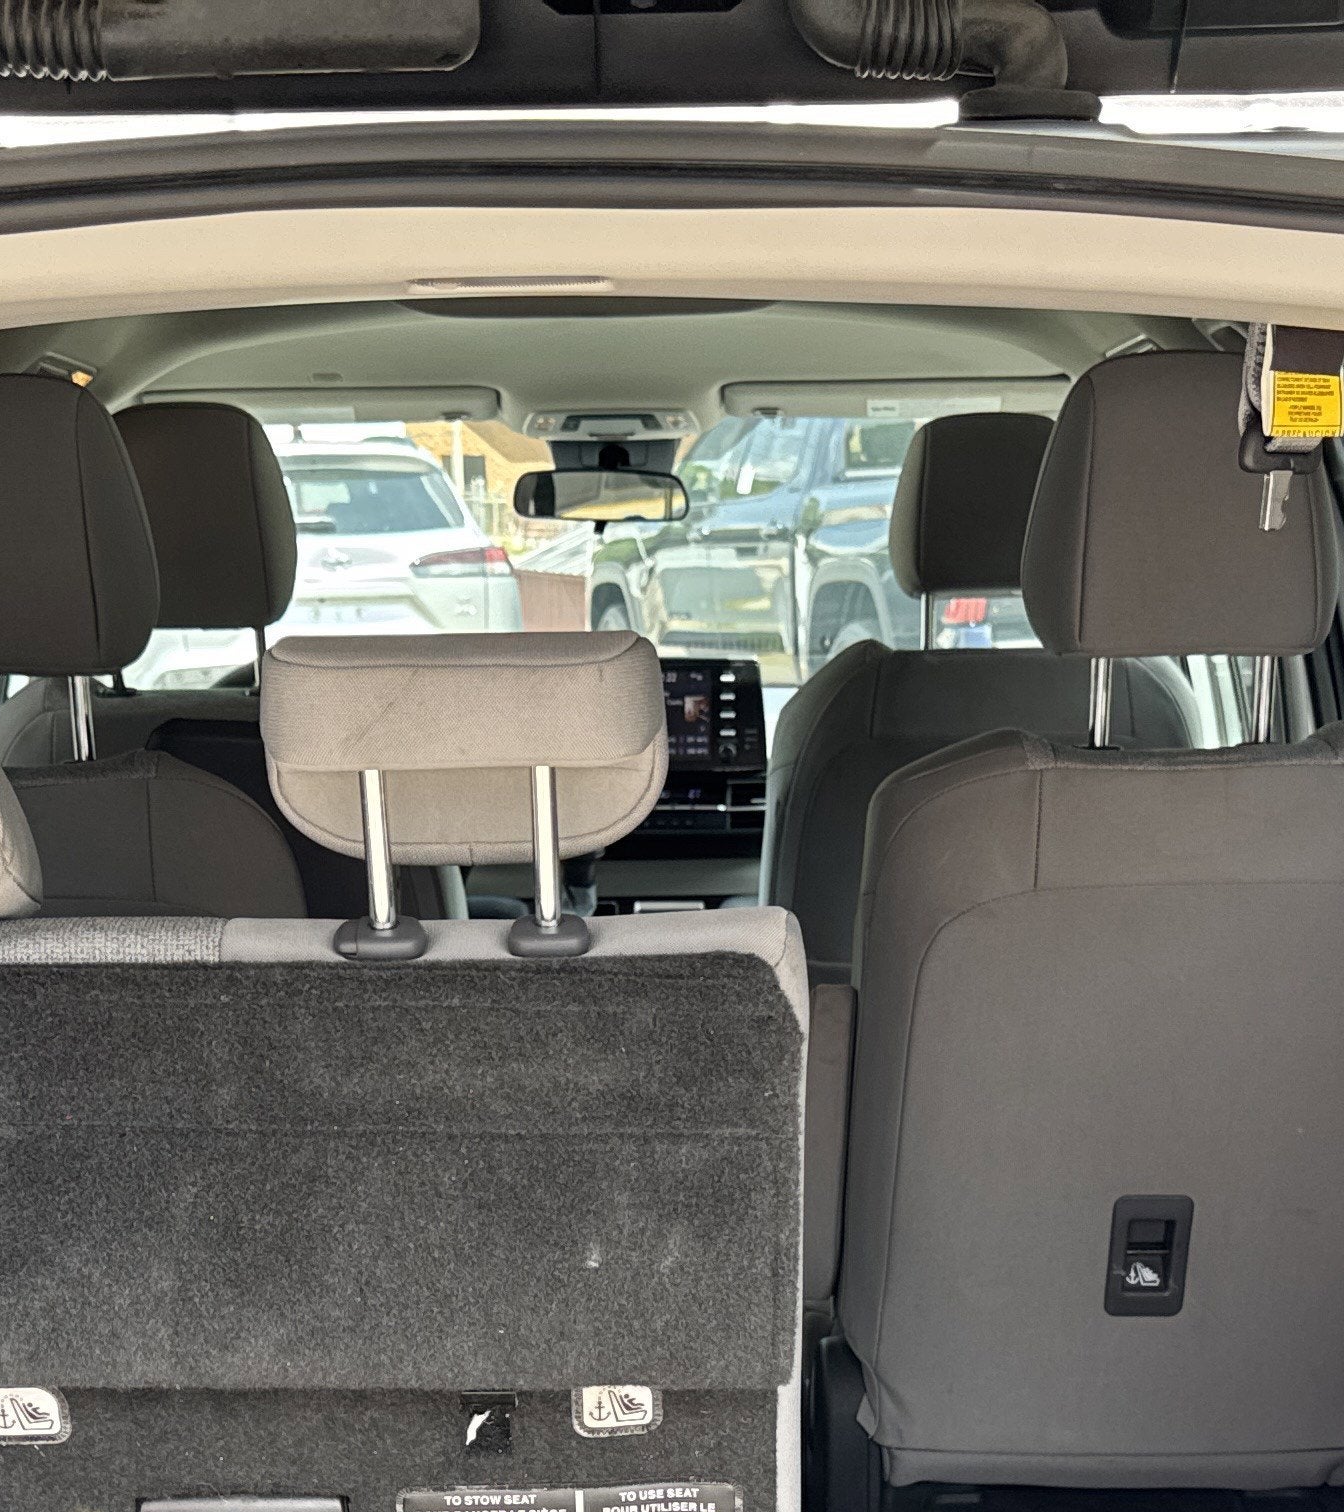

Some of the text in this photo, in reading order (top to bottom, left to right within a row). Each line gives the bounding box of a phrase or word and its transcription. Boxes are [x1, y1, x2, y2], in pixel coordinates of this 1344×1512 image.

[444, 1494, 537, 1506] TO STOW SEAT
[619, 1487, 700, 1503] TO USE SEAT
[699, 1502, 716, 1512] LE
